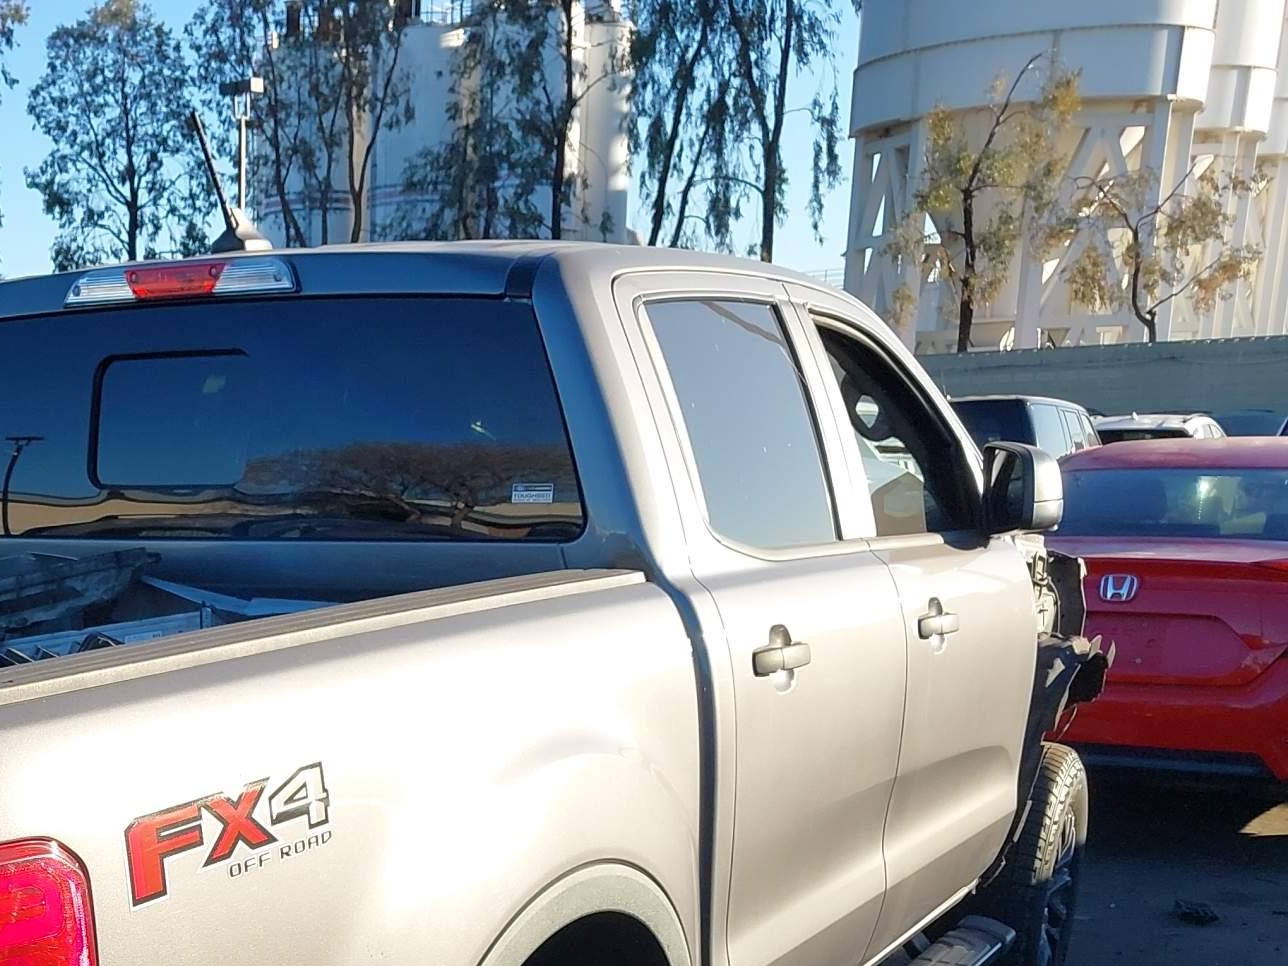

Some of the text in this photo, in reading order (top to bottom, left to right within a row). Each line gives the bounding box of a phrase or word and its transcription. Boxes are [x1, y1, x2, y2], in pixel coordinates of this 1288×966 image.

[124, 761, 331, 907] FX4
[229, 830, 333, 878] OFF ROAD
